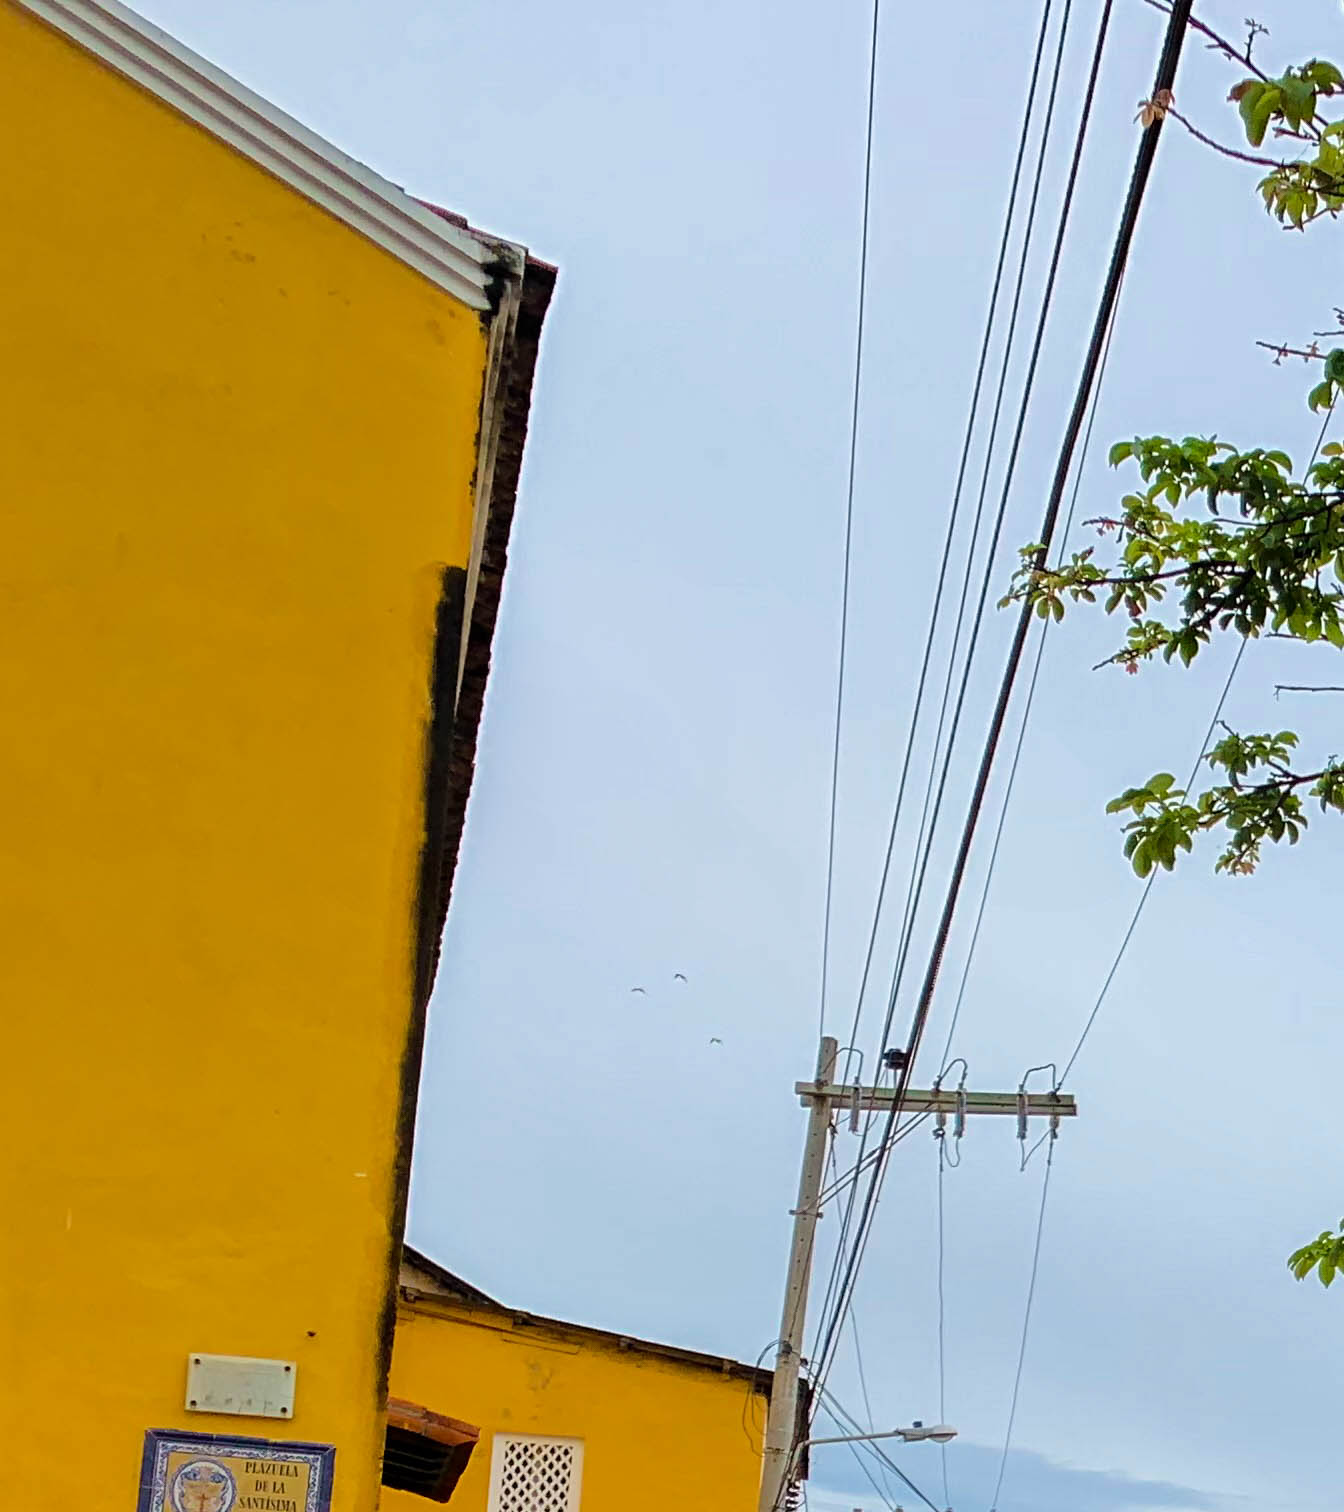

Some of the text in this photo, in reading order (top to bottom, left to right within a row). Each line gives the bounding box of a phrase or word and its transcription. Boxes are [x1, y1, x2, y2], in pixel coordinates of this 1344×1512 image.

[245, 1461, 298, 1477] PLAZUELA
[255, 1480, 285, 1494] DE LA
[239, 1495, 297, 1512] SANTÍSIMA
